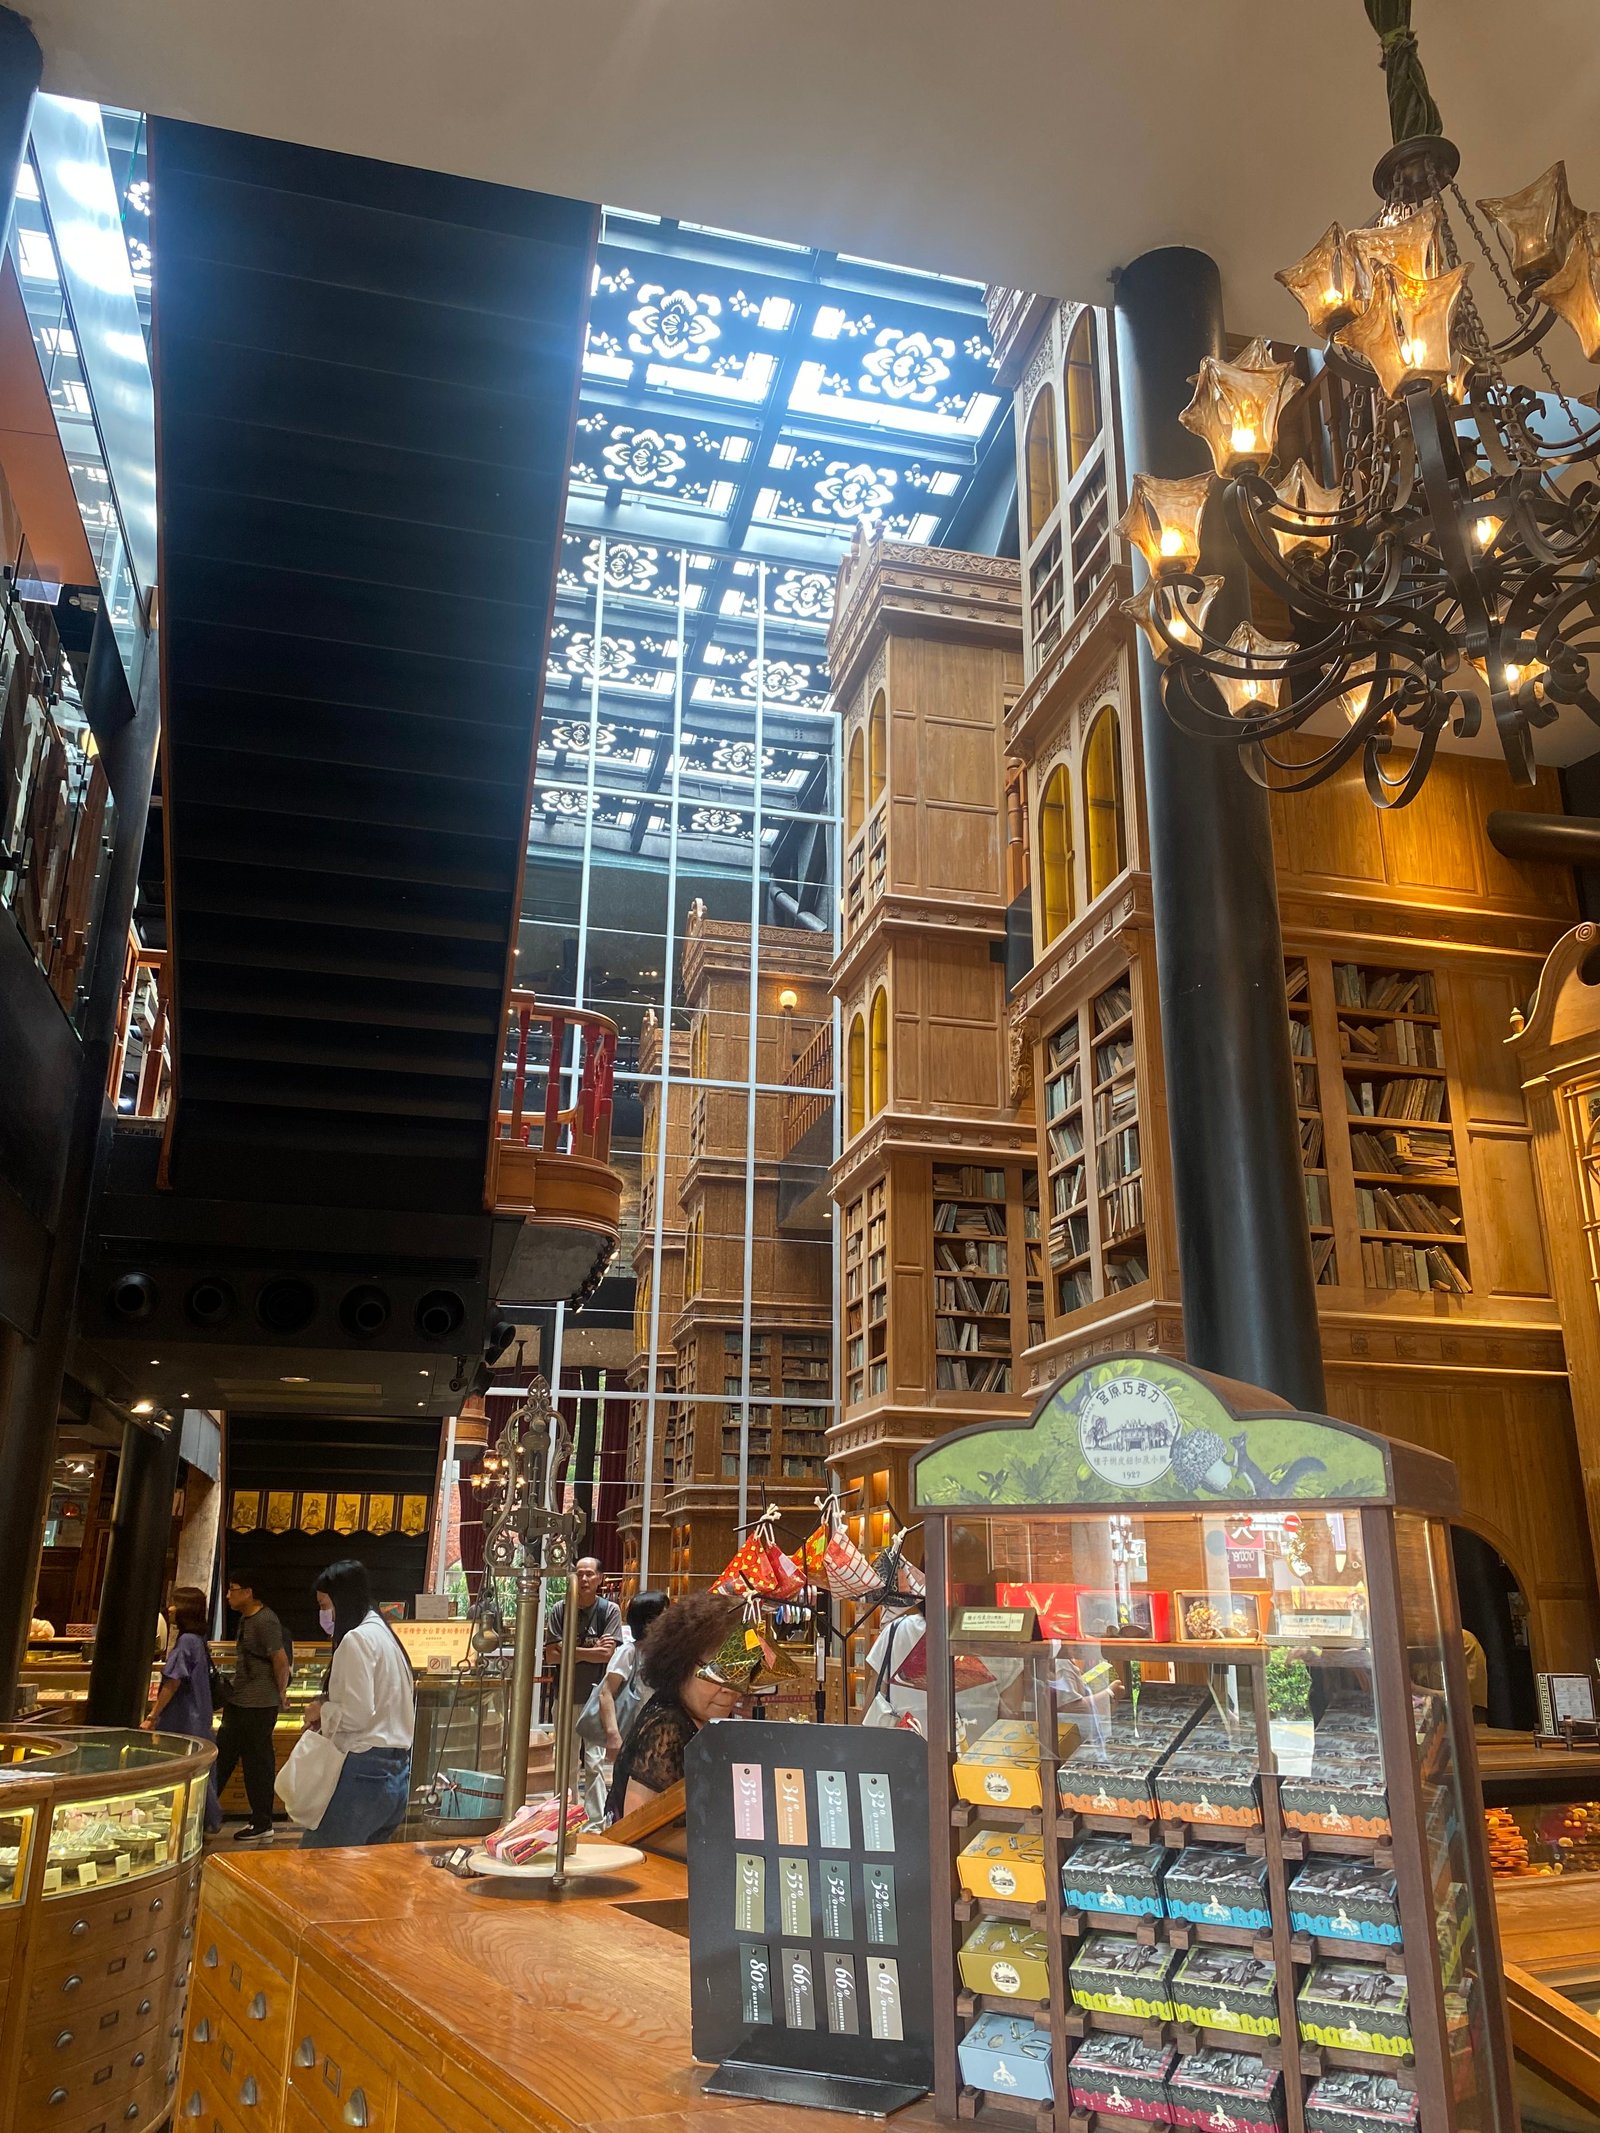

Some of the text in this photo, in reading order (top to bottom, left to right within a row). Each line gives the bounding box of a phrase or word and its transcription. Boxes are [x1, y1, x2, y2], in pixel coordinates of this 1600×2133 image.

[1095, 1381, 1160, 1406] 宮原巧克力
[1122, 1470, 1141, 1480] 1927
